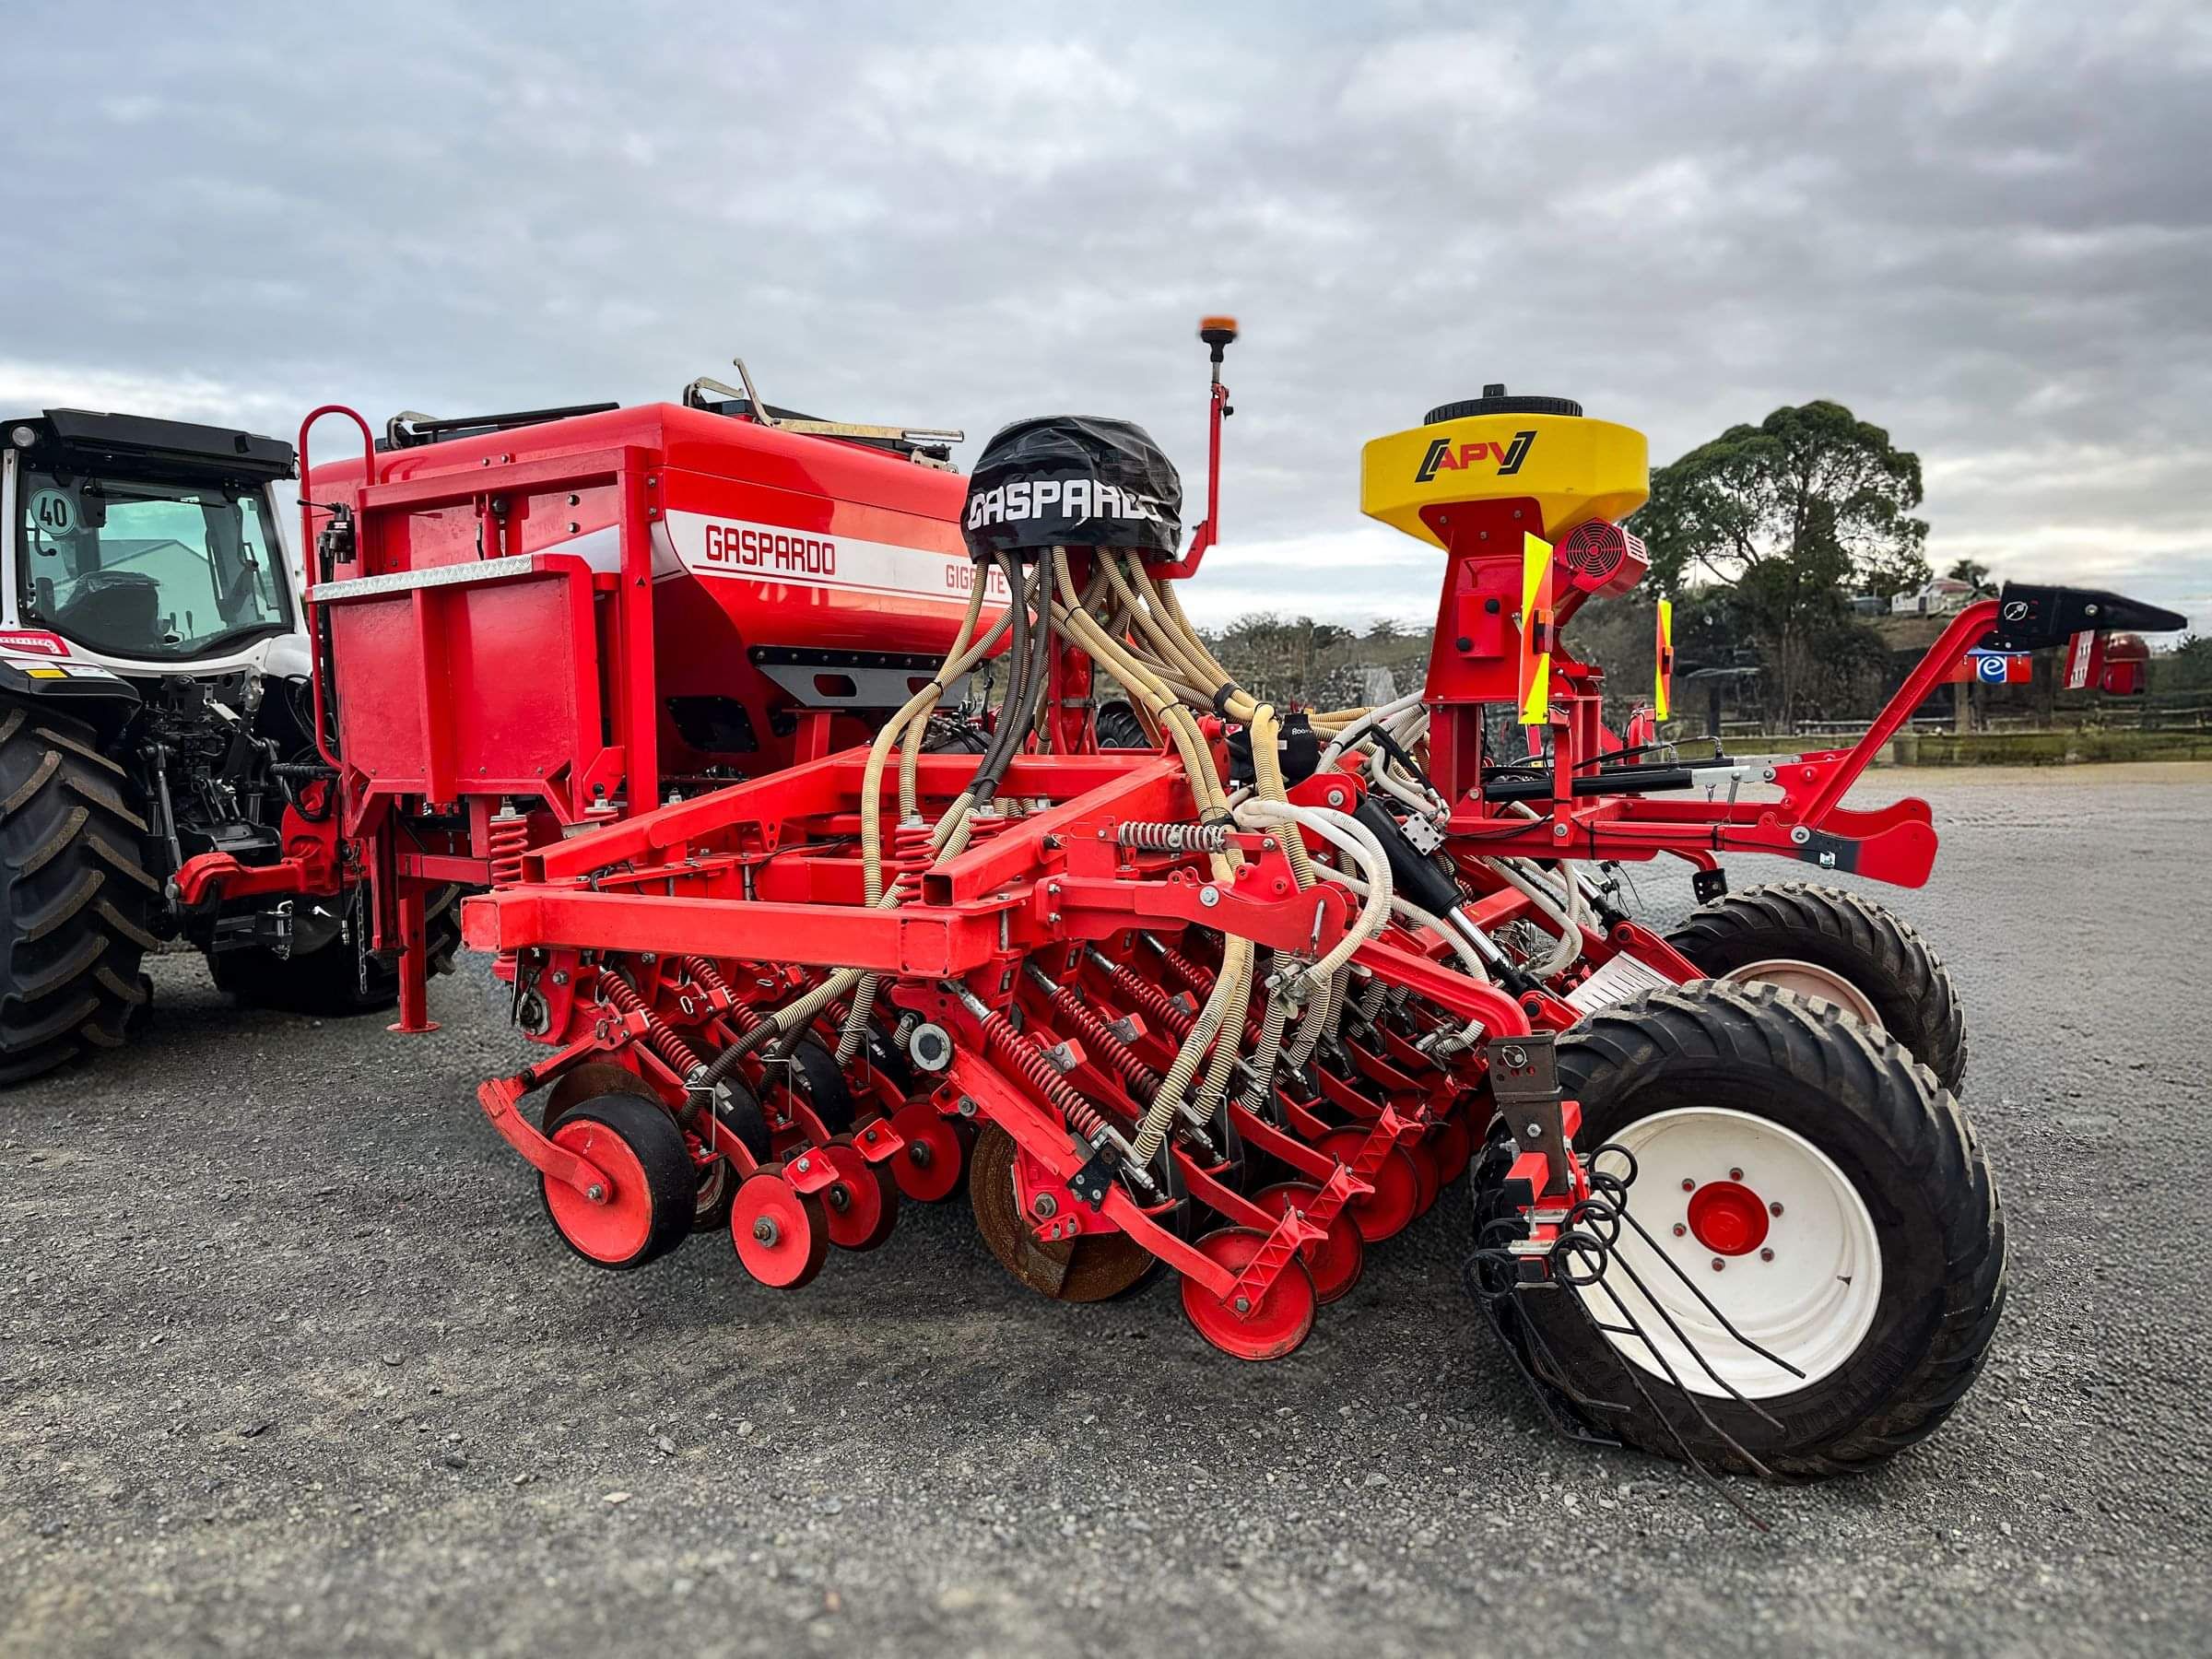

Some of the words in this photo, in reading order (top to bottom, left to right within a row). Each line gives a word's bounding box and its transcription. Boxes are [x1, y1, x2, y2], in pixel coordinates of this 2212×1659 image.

[1428, 437, 1526, 474] APV
[40, 497, 67, 527] 40
[706, 524, 835, 575] GASPARDO
